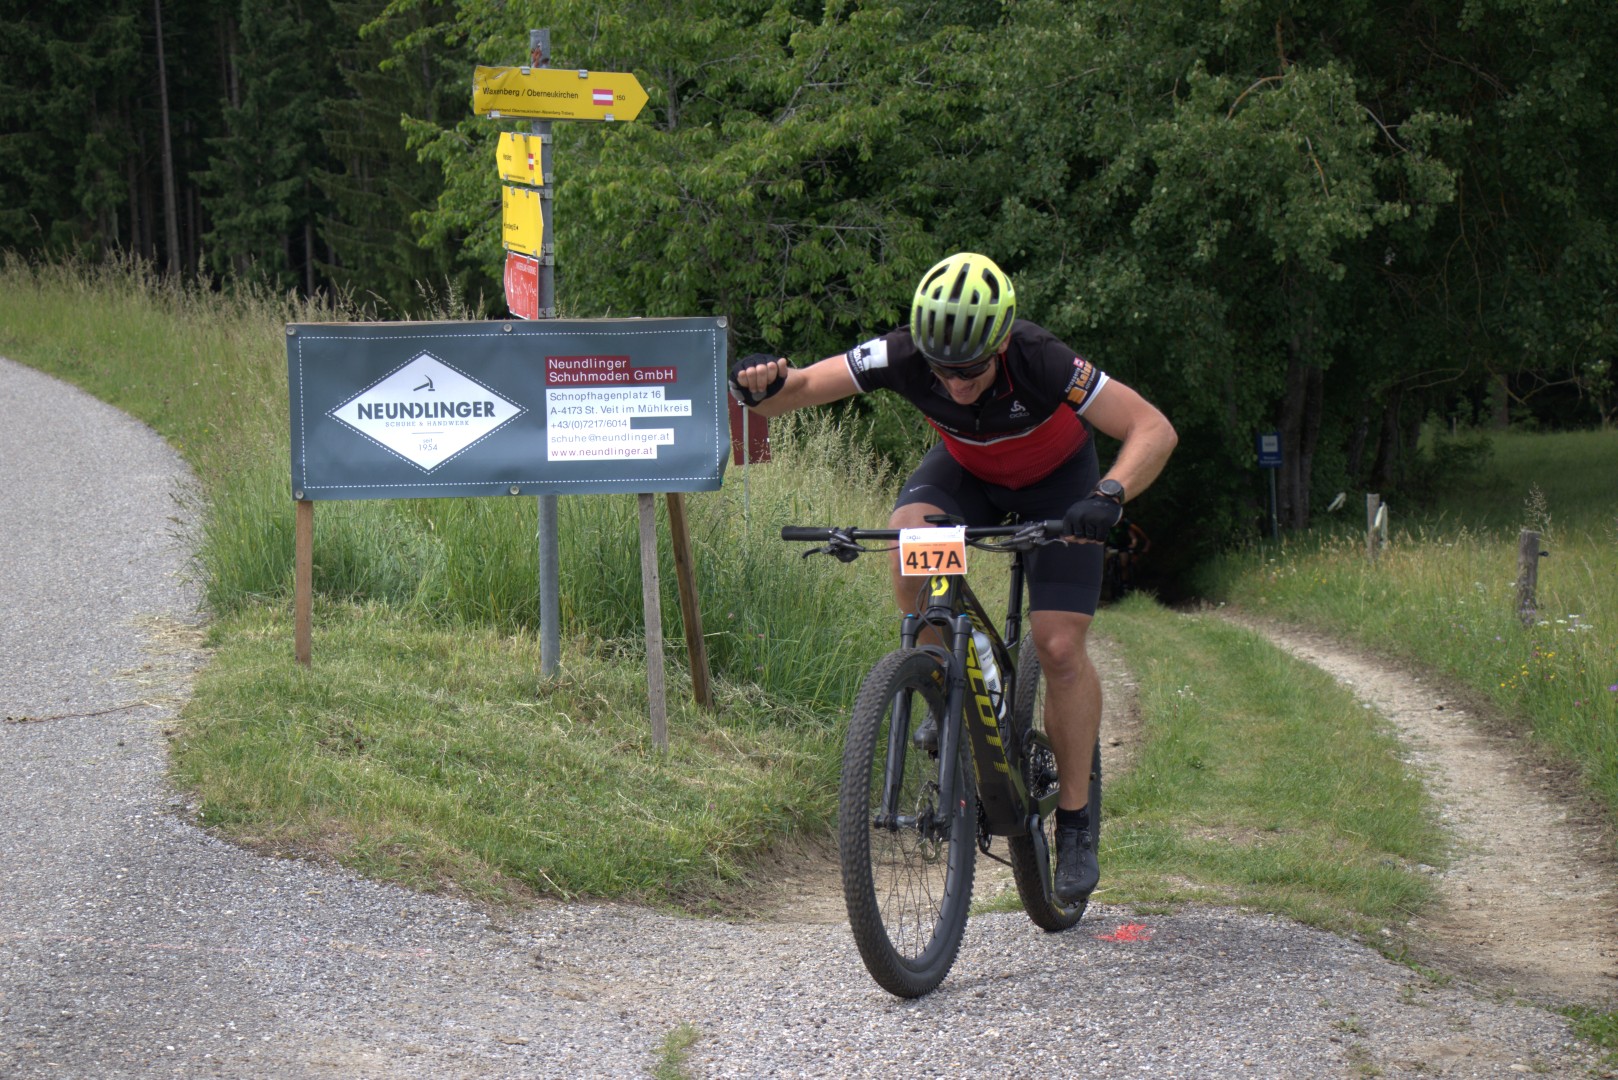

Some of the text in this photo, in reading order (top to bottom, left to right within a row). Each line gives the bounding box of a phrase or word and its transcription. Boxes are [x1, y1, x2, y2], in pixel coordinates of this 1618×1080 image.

[482, 87, 520, 97] Waxenberg
[527, 88, 579, 99] Oberneukirchen
[549, 358, 627, 370] Neundlinger
[549, 369, 674, 382] Schuhmoden GmbH
[549, 390, 661, 402] Schnopfhagenplatz 16
[357, 401, 496, 419] NEUNDLINGER
[550, 404, 689, 415] A-4173 St. Veit im Mühlkreis
[551, 419, 627, 429] +43/(0)7217/6014
[418, 443, 438, 451] 1954
[551, 446, 653, 457] www.neundlinger.at
[905, 550, 962, 570] 417A
[966, 636, 1012, 780] SCOTT
